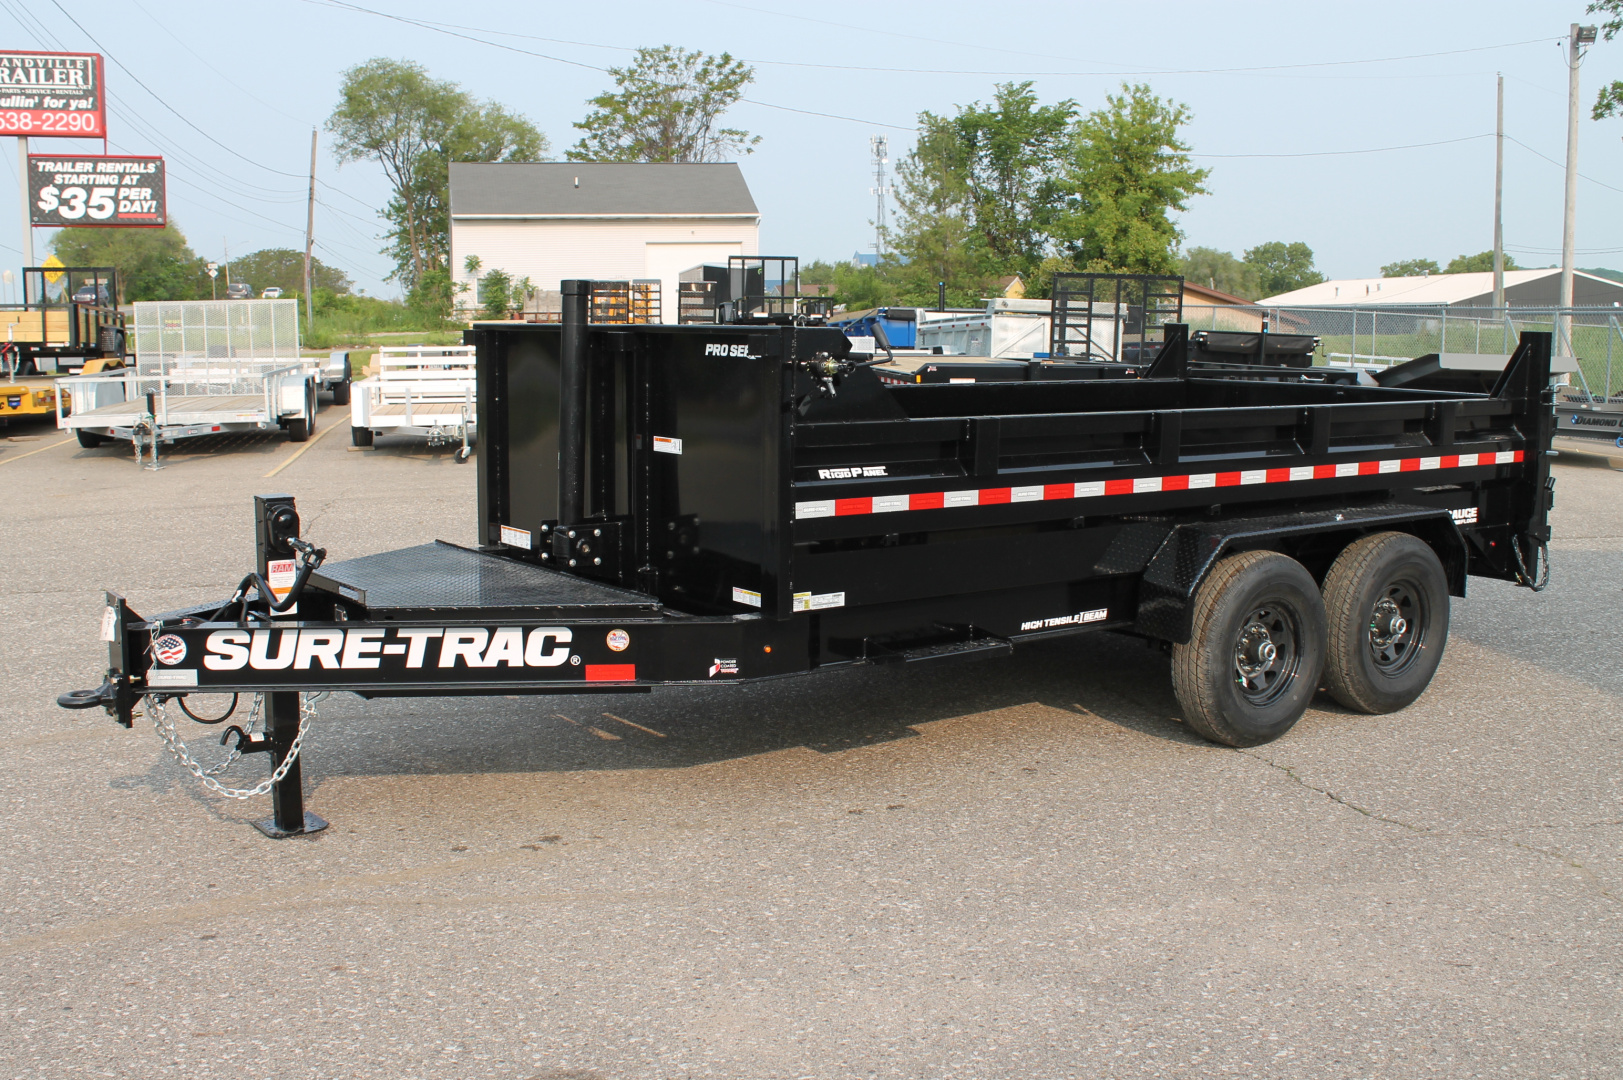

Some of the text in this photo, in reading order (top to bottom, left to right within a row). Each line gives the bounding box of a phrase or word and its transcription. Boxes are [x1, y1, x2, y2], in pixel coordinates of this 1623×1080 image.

[1, 58, 84, 69] ANDVILLE
[0, 67, 84, 85] RAILER
[43, 96, 66, 108] for
[69, 97, 94, 110] ya!
[37, 162, 156, 173] TRAILER RENTALS
[54, 174, 140, 185] STARTING AT
[118, 187, 152, 200] PER
[37, 184, 116, 220] $35
[118, 200, 157, 213] DAY!
[705, 343, 728, 357] PRO
[1577, 416, 1617, 427] DIAMOND
[1448, 507, 1477, 520] AUGE
[271, 563, 293, 573] RAM
[1021, 620, 1043, 631] HIGH
[1044, 614, 1079, 627] TENSILE
